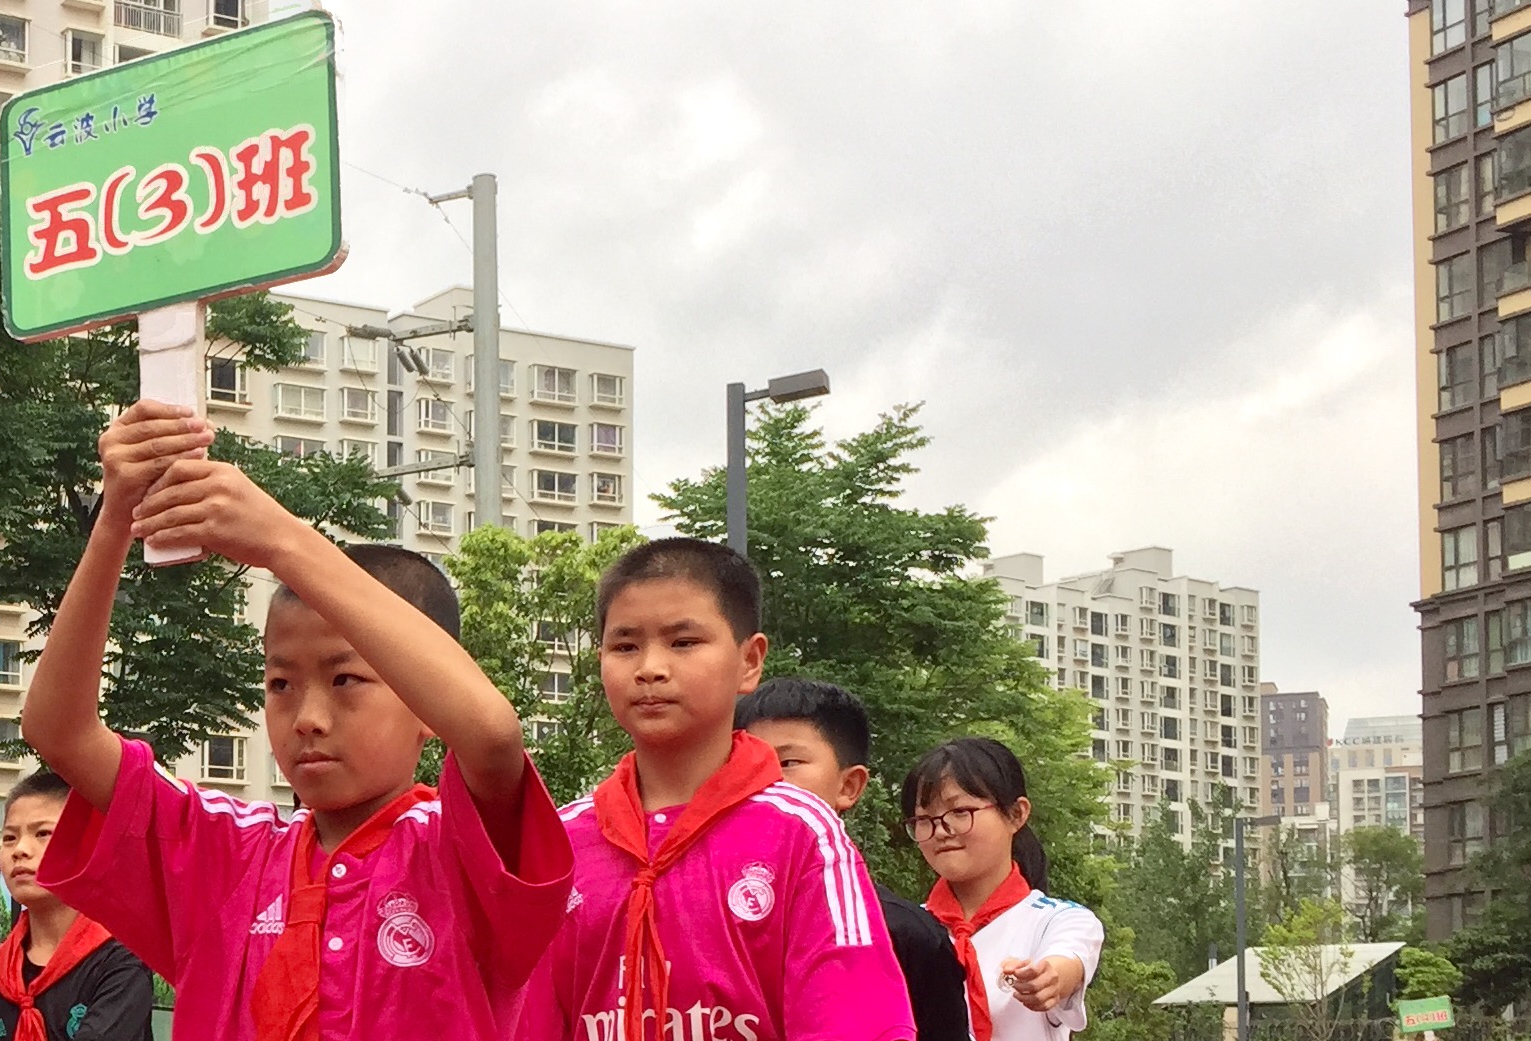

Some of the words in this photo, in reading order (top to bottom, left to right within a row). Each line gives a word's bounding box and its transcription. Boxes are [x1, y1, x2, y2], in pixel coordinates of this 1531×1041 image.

[44, 93, 160, 149] 云波小学
[27, 128, 314, 276] 五(3)班
